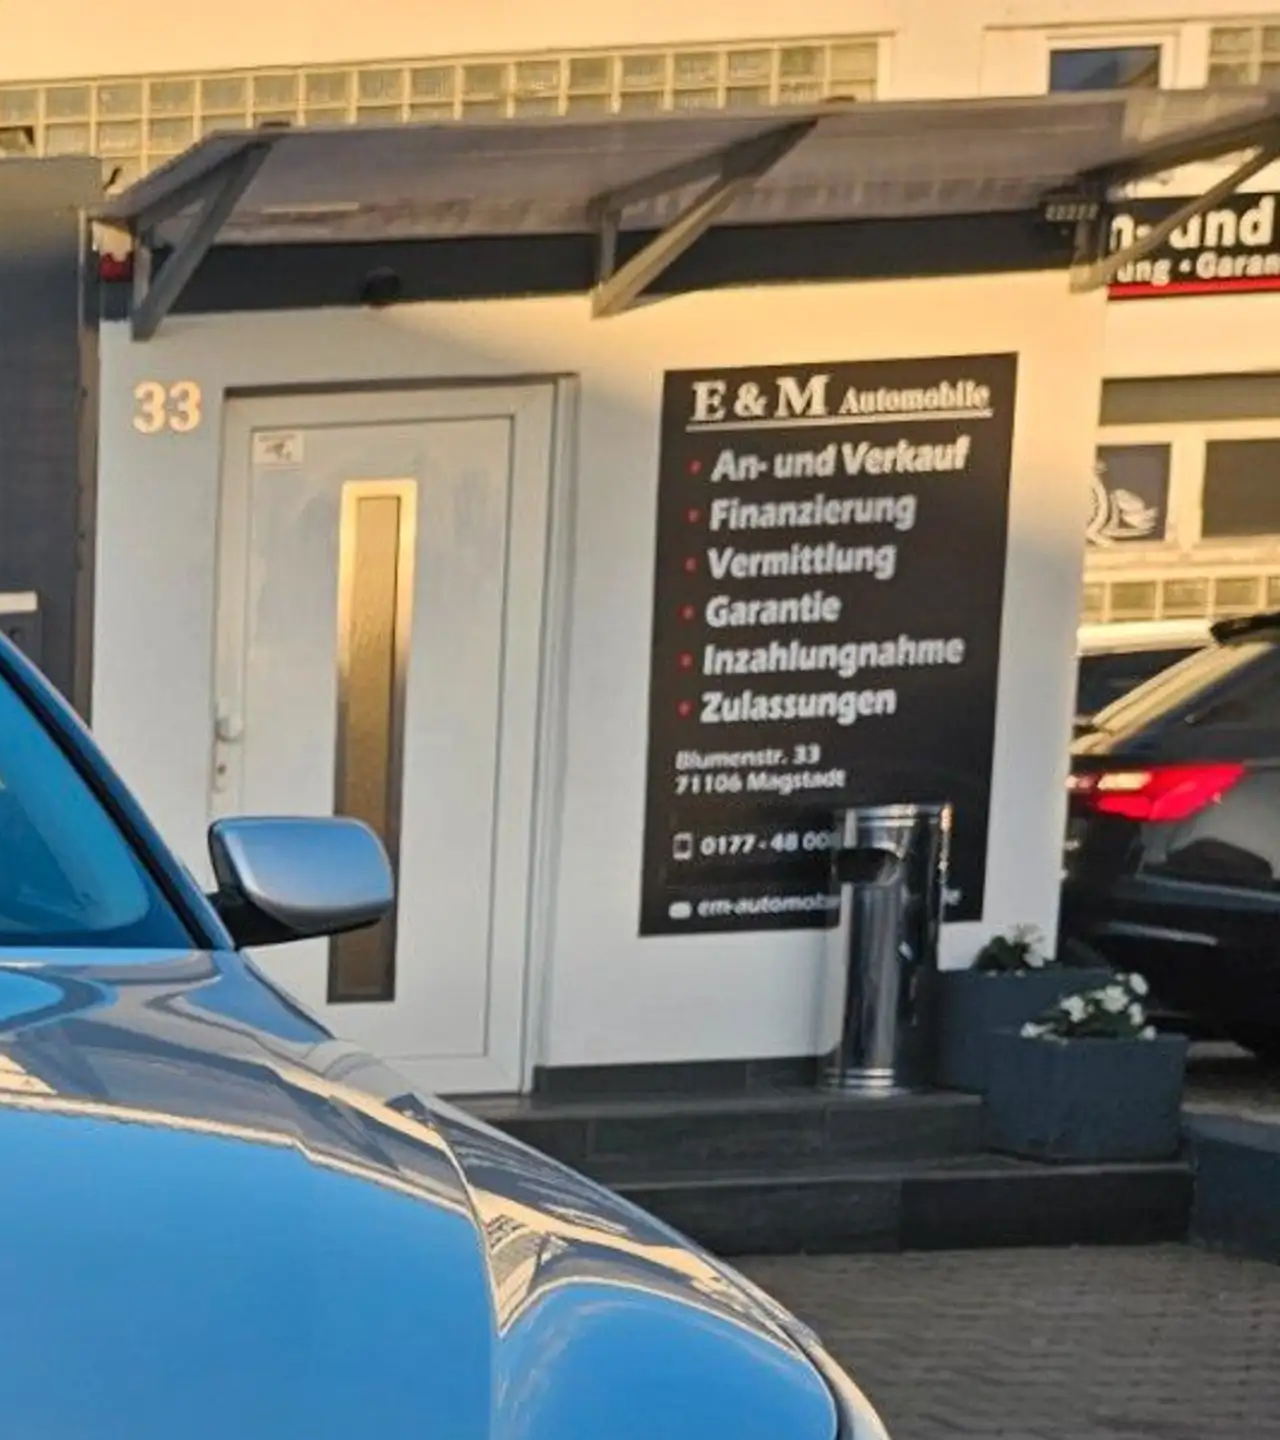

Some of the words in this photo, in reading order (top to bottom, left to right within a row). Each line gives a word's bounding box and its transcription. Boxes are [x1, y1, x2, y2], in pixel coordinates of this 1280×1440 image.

[133, 380, 201, 434] 33
[692, 379, 727, 422] E
[733, 382, 768, 418] &
[774, 373, 831, 417] M
[838, 378, 990, 416] Automobile
[710, 448, 768, 482] An-
[773, 443, 838, 478] und
[842, 435, 971, 476] Verkauf
[708, 494, 918, 531] Finanzierung
[707, 543, 899, 580] Vermittlung
[704, 590, 842, 628] Garantie
[702, 634, 966, 678] Inzahlungnahme
[699, 688, 897, 726] Zulassungen
[674, 748, 788, 771] Blumenstr.
[792, 742, 821, 766] 33
[675, 773, 742, 795] 71106
[746, 767, 847, 795] Magstadt
[699, 832, 754, 856] 0177
[770, 829, 798, 852] 48
